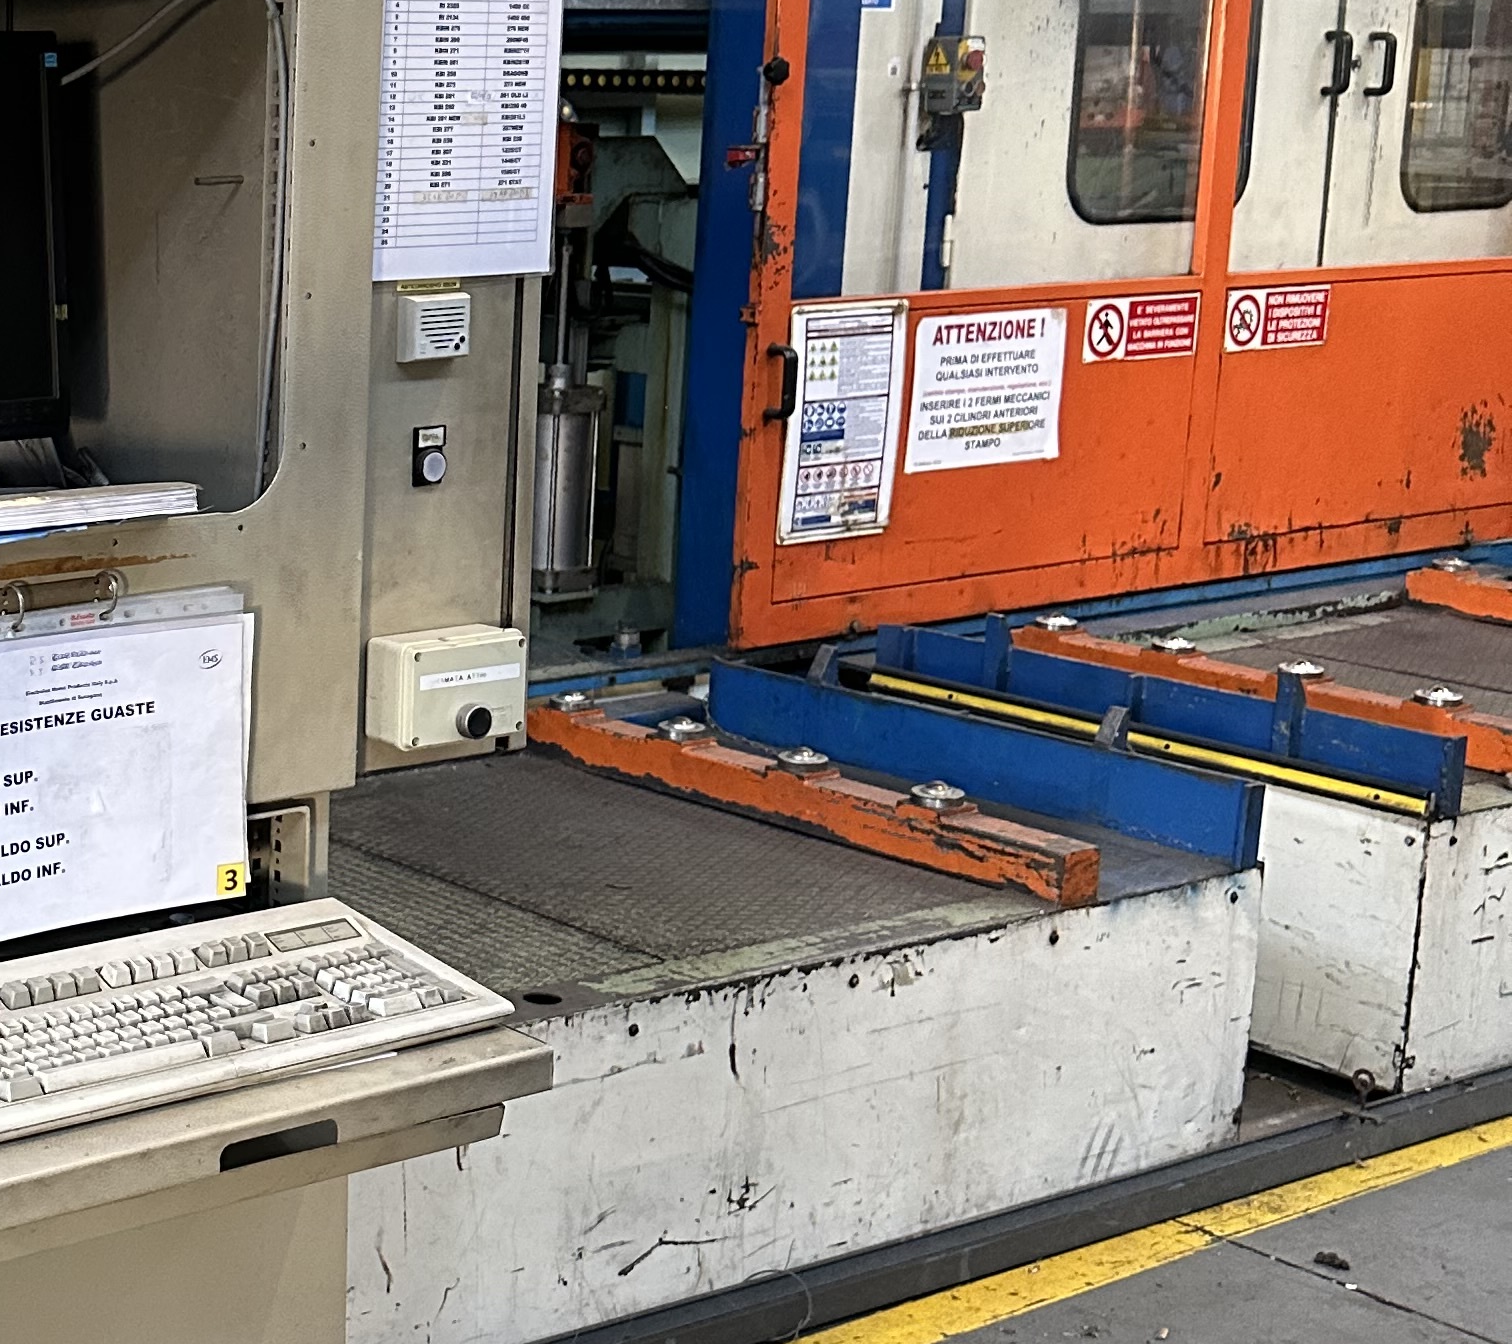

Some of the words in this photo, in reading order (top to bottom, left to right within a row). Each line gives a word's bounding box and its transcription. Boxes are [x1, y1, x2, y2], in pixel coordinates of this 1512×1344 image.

[1268, 294, 1285, 305] NON
[1285, 292, 1325, 305] RIMUOVERE
[1272, 305, 1315, 318] DISPOSITIVI
[932, 318, 1036, 346] ATTENZIONE
[1040, 317, 1046, 338] !
[1267, 319, 1277, 331] LE
[1278, 317, 1321, 330] PROTEZIONI
[1267, 332, 1275, 343] DI
[1276, 329, 1318, 342] SICUREZZA
[940, 354, 968, 367] PRIMA
[970, 353, 979, 364] DI
[981, 349, 1036, 364] EFFETTUARE
[935, 367, 983, 382] QUALSIASI
[984, 363, 1039, 377] INTERVENTO
[920, 398, 961, 412] INSERIRE
[967, 397, 973, 408] 2
[975, 395, 1002, 407] FERMI
[1003, 391, 1050, 404] MECCANICI
[929, 415, 945, 425] SUI
[946, 414, 952, 424] 2
[954, 410, 991, 423] CILINDRI
[993, 406, 1038, 419] ANTERIORI
[918, 429, 947, 441] DELLA
[949, 423, 996, 438] RIDUZIONE
[998, 419, 1046, 434] SUPERIORE
[964, 437, 1001, 450] STAMPO
[201, 651, 220, 665] EMS
[90, 700, 156, 722] GUASTE
[3, 770, 39, 790] SUP.
[4, 799, 35, 817] INF.
[35, 832, 70, 851] SUP.
[35, 861, 66, 879] INF.
[223, 868, 238, 892] 3
